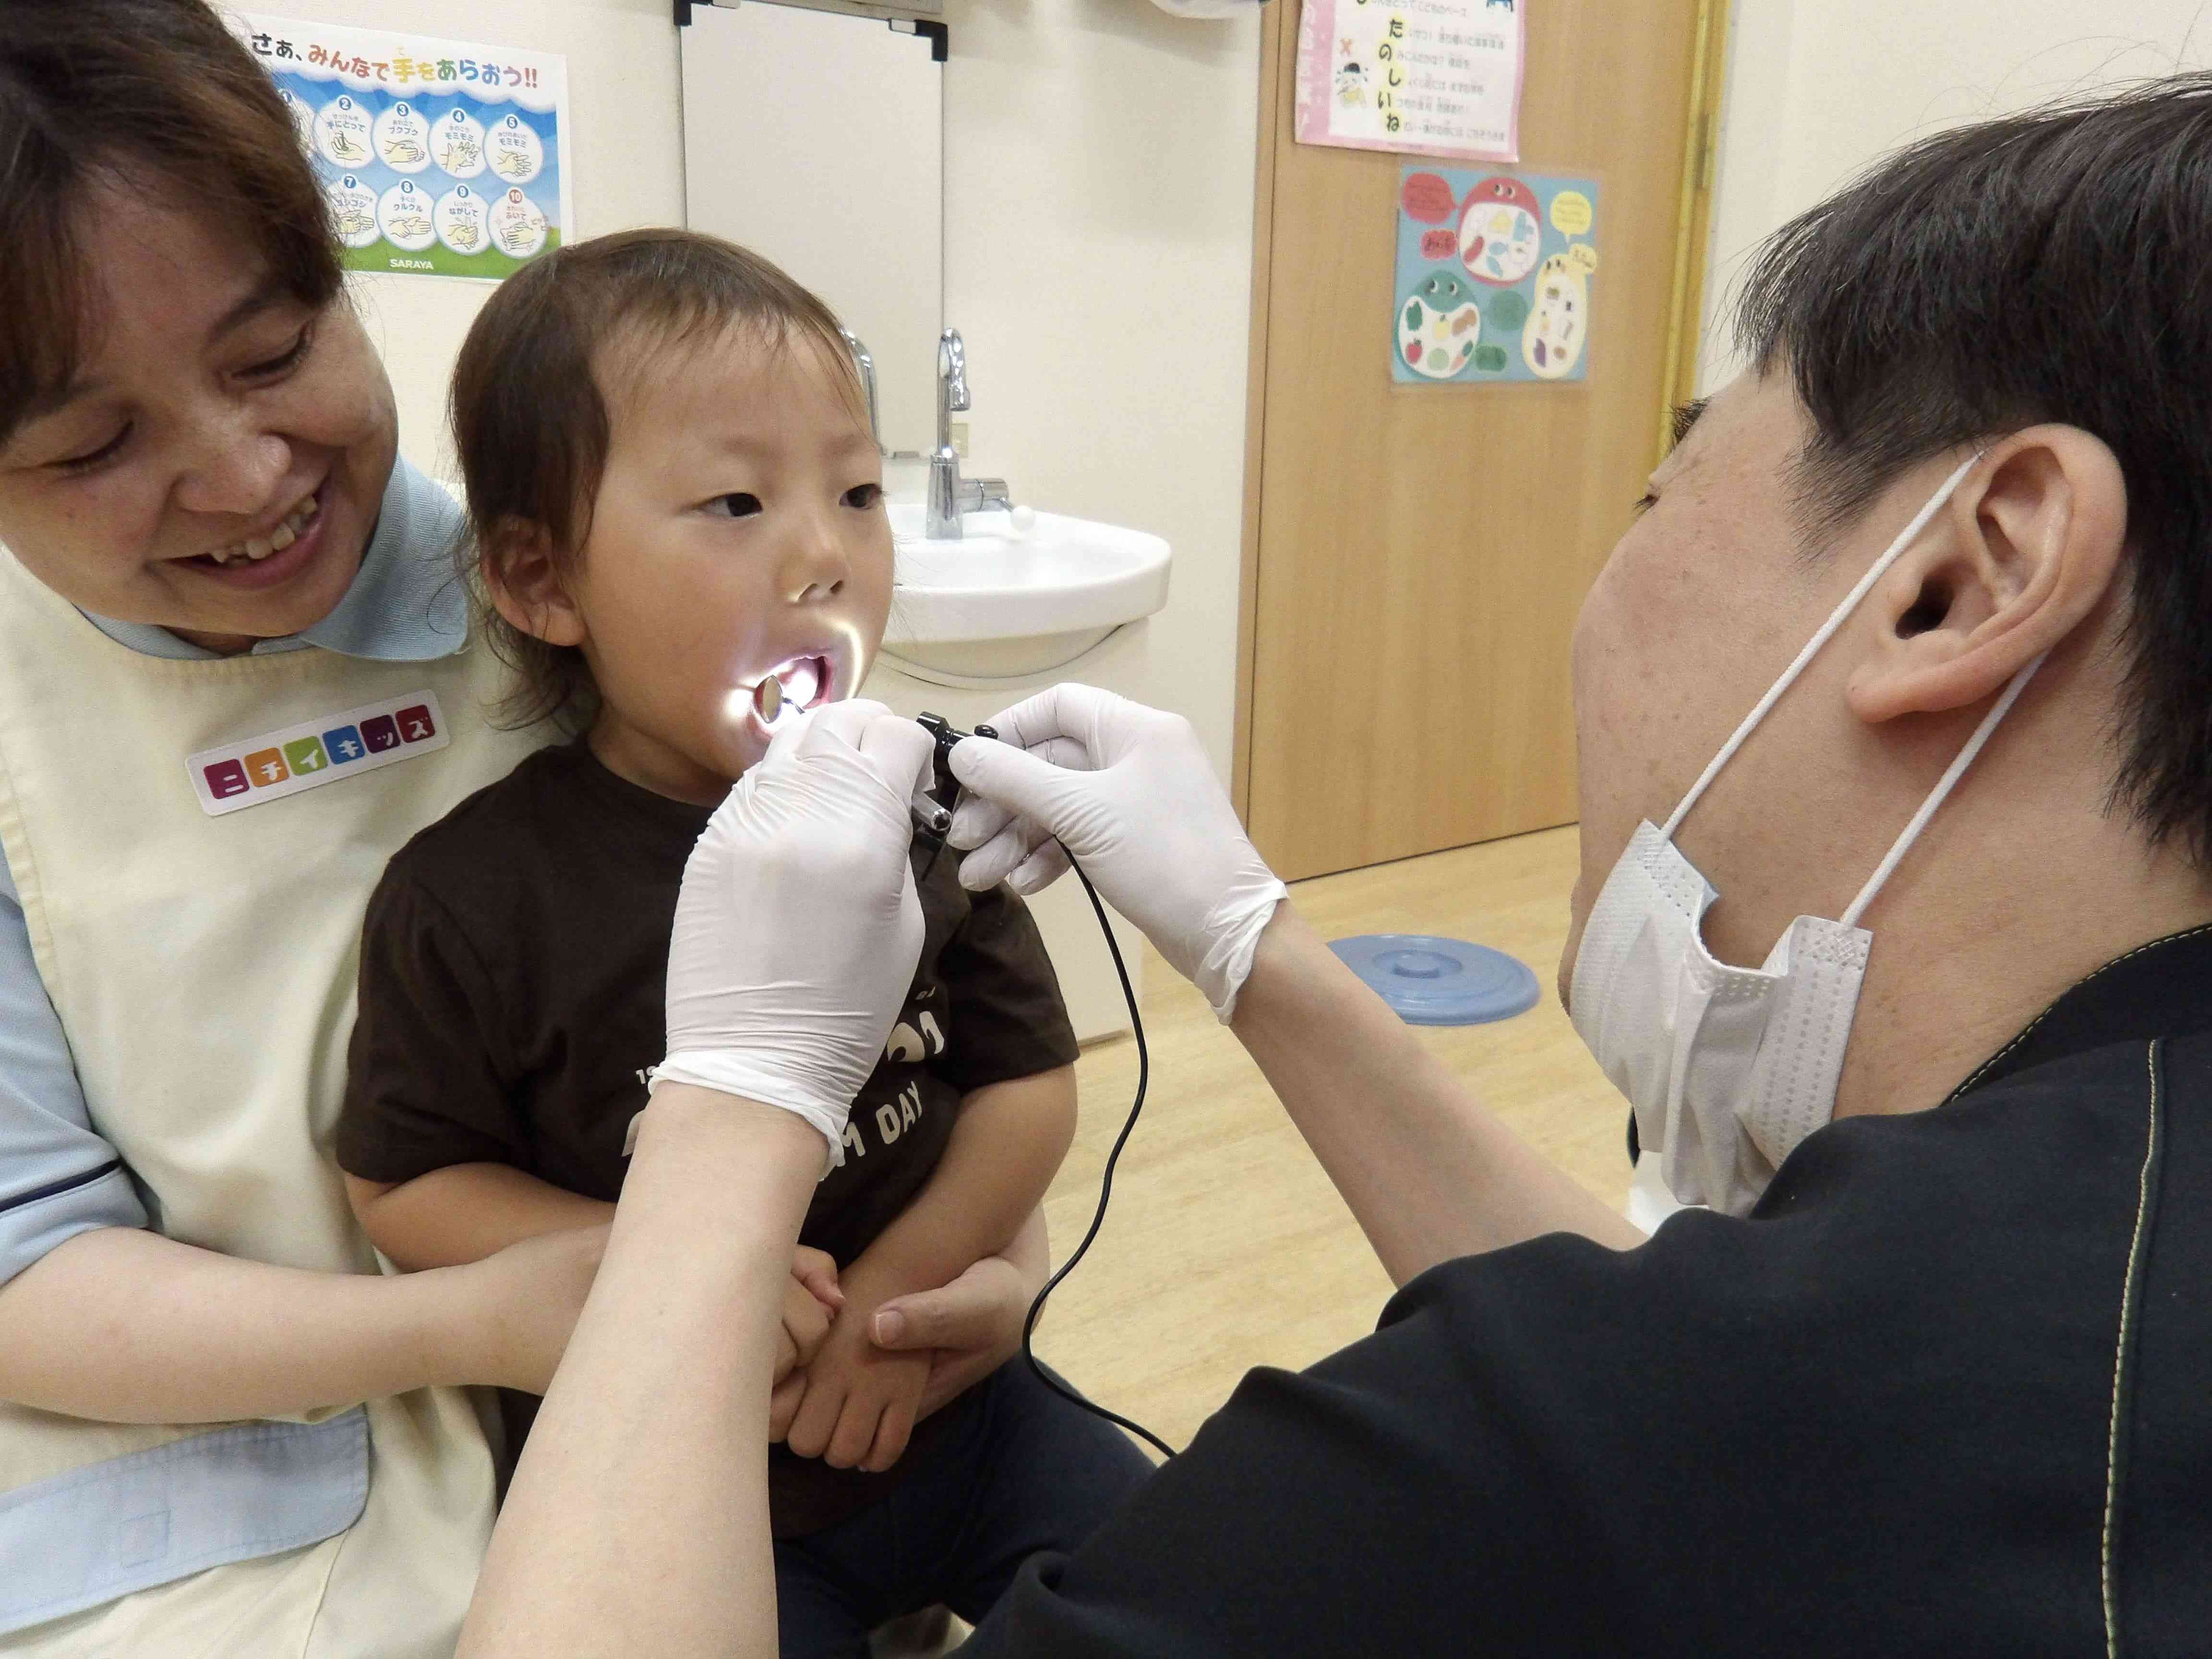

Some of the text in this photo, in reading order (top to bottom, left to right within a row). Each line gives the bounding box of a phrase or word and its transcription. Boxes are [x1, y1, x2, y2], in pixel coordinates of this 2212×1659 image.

[509, 190, 521, 203] 10
[393, 203, 423, 213] クルクル
[390, 259, 434, 270] SARAYA
[223, 717, 429, 793] ニチイキッズ
[876, 1081, 923, 1144] DAY
